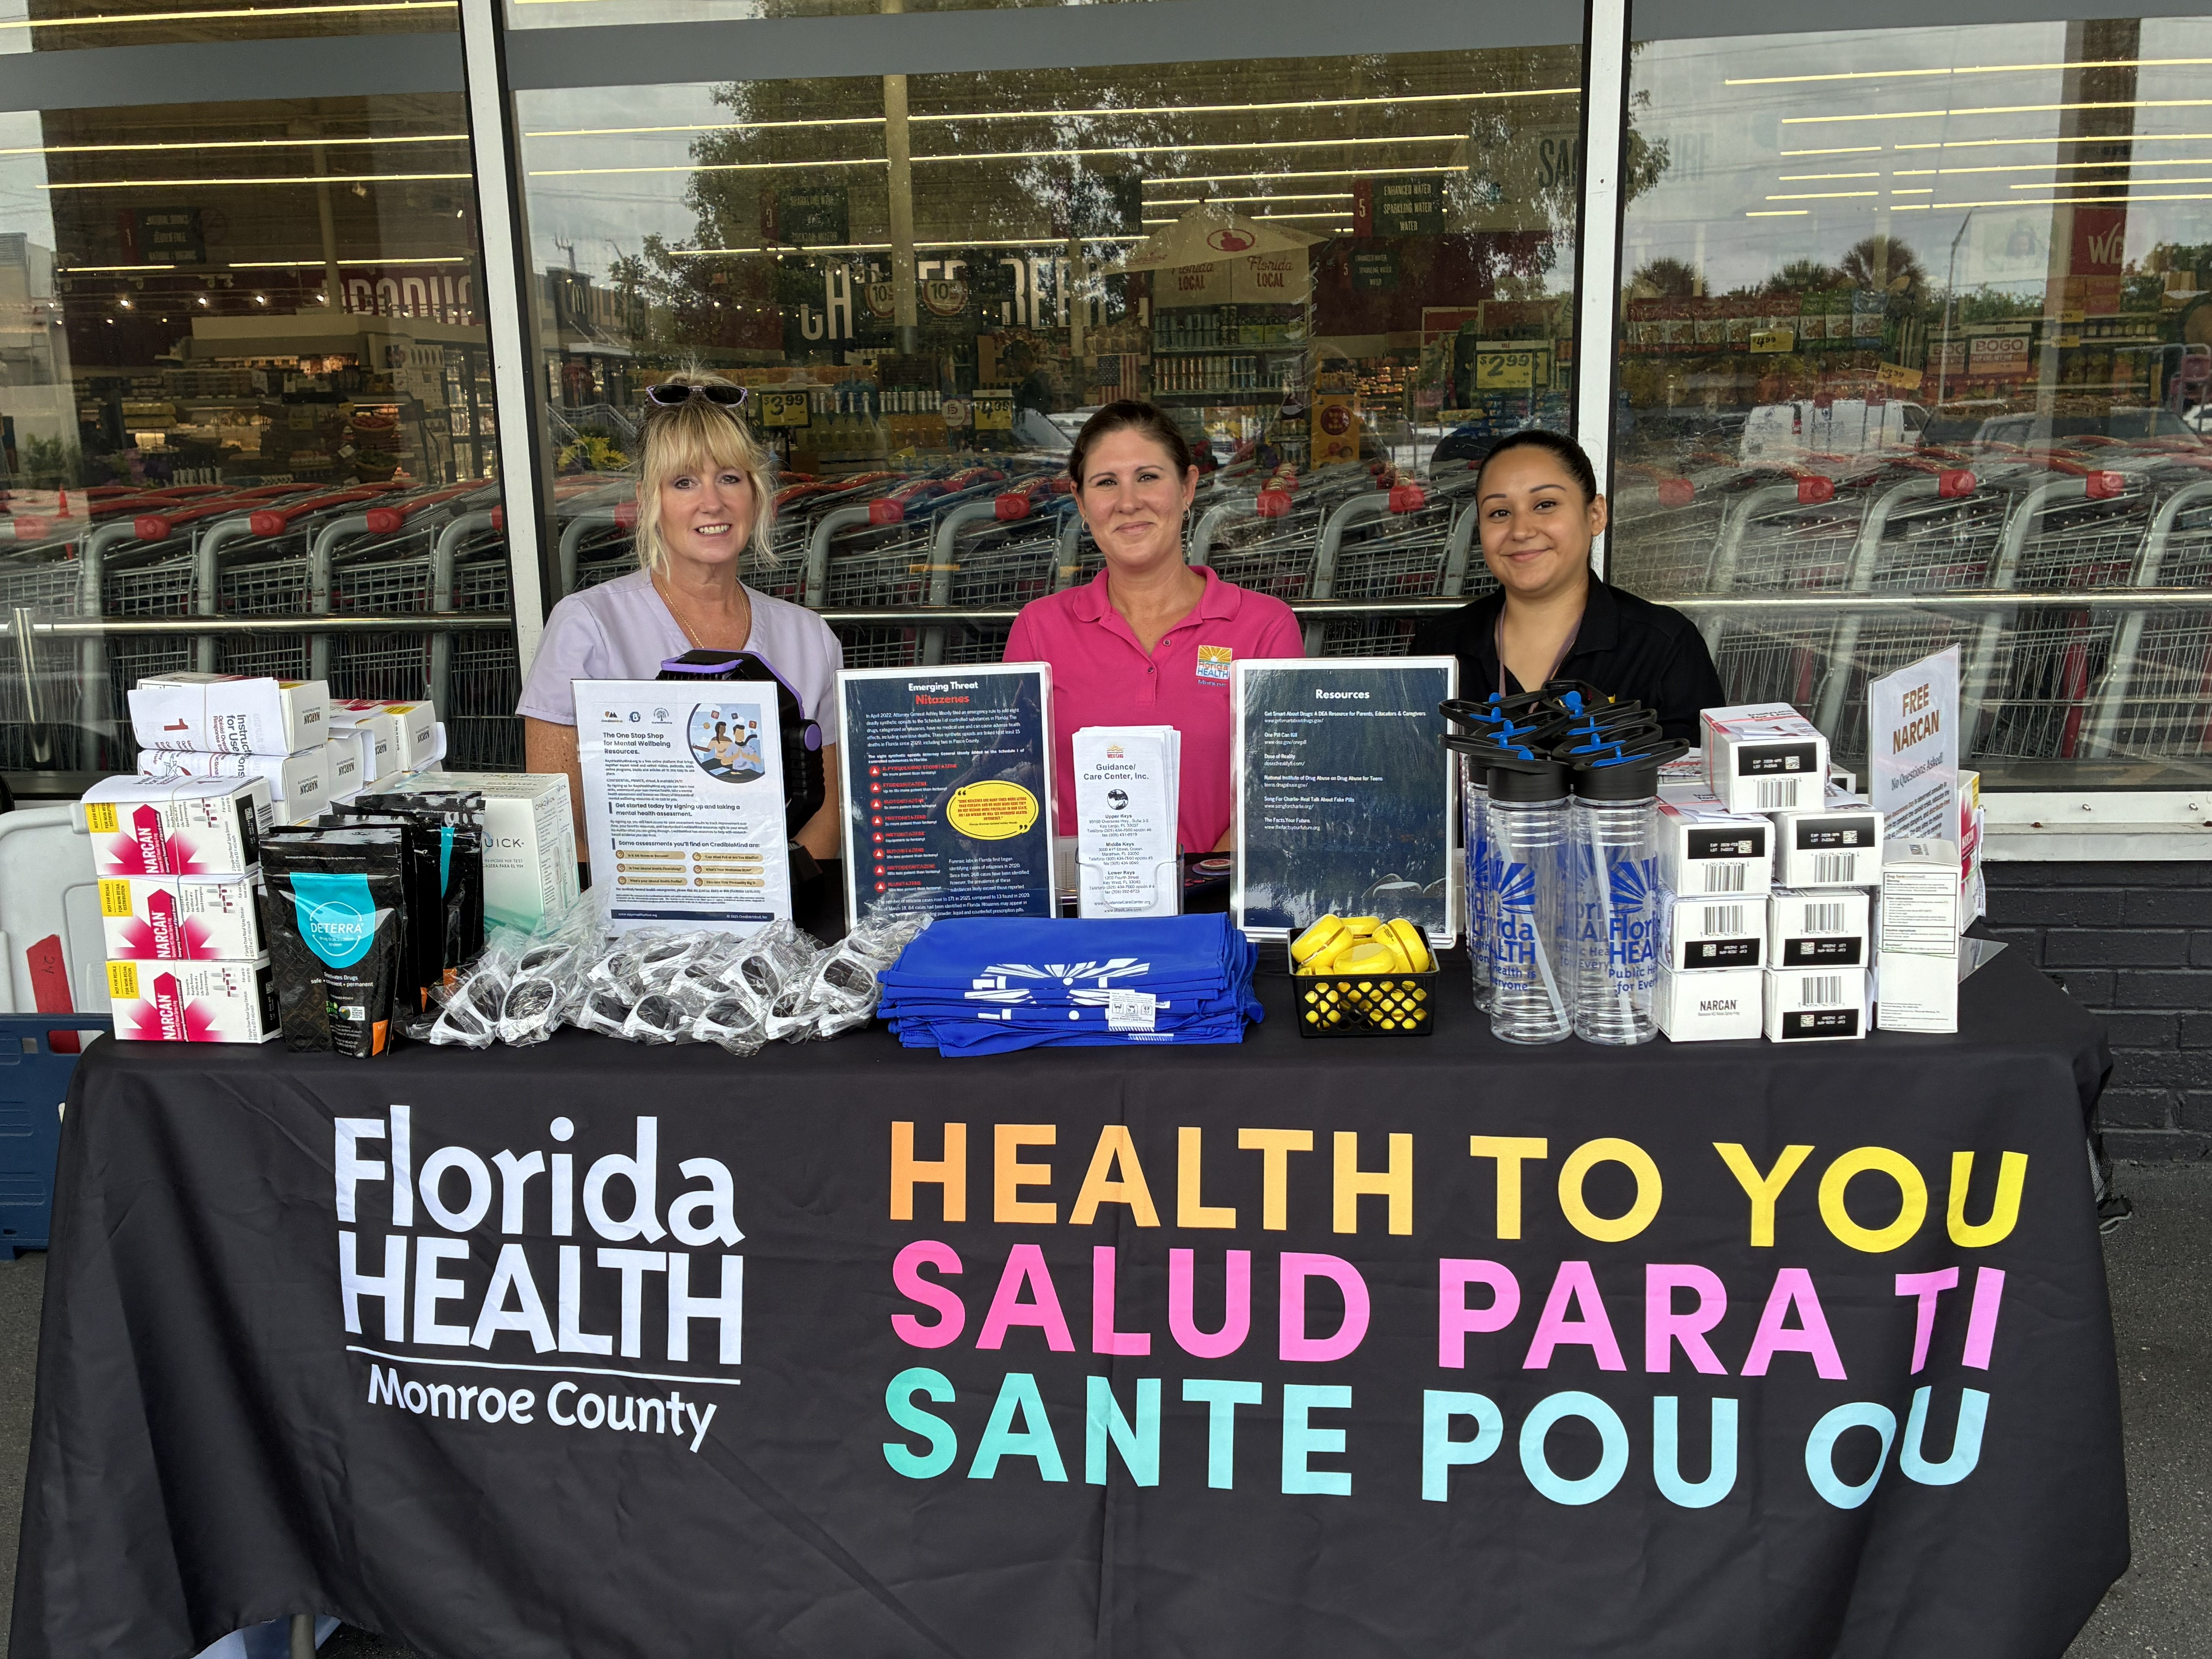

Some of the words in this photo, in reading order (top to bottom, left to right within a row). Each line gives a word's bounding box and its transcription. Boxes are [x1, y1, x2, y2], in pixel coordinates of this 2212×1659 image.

[1384, 185, 1412, 195] ENHANCED
[1414, 184, 1431, 194] WATER
[1359, 199, 1365, 217] 5
[1383, 203, 1413, 214] SPARKLING
[1414, 202, 1432, 212] WATER
[1400, 221, 1417, 230] WATER
[1247, 256, 1293, 271] Florida
[1179, 276, 1205, 290] LOCAL
[1257, 273, 1284, 287] LOCAL
[872, 285, 887, 302] 10
[930, 283, 949, 299] 10
[1976, 339, 2023, 352] BOGO
[1198, 668, 1228, 677] HEALTH
[1199, 662, 1228, 670] Florida
[908, 682, 949, 692] Emerging
[950, 681, 979, 690] Threat
[915, 695, 970, 705] Nitazenes
[1316, 689, 1370, 699] Resources
[1903, 683, 1929, 717] FREE
[164, 718, 189, 731] 1
[227, 715, 235, 731] for
[304, 712, 320, 725] NARCAN
[1893, 709, 1939, 754] NARCAN
[229, 733, 239, 752] Use
[338, 762, 354, 776] NARCAN
[300, 780, 318, 795] NARCAN
[138, 826, 159, 874] NARCAN
[152, 912, 171, 958] NARCAN
[311, 923, 364, 933] DETERRA
[1527, 970, 1536, 979] is
[1609, 967, 1645, 978] Public
[1617, 981, 1634, 994] for
[1700, 1000, 1738, 1011] NARCAN
[158, 995, 176, 1039] NARCAN
[334, 1104, 745, 1247] Florida
[890, 1121, 1413, 1235] HEALTH
[1470, 1135, 1662, 1243] TO
[1712, 1142, 2028, 1253] YOU
[338, 1230, 744, 1365] HEALTH
[891, 1240, 1370, 1362] SALUD
[1438, 1258, 1848, 1380] PARA
[1894, 1266, 2006, 1376] TI
[368, 1364, 534, 1425] Monroe
[546, 1381, 717, 1453] County
[883, 1367, 1352, 1496] SANTE
[1421, 1389, 1738, 1509] POU
[1805, 1386, 1990, 1510] OU
